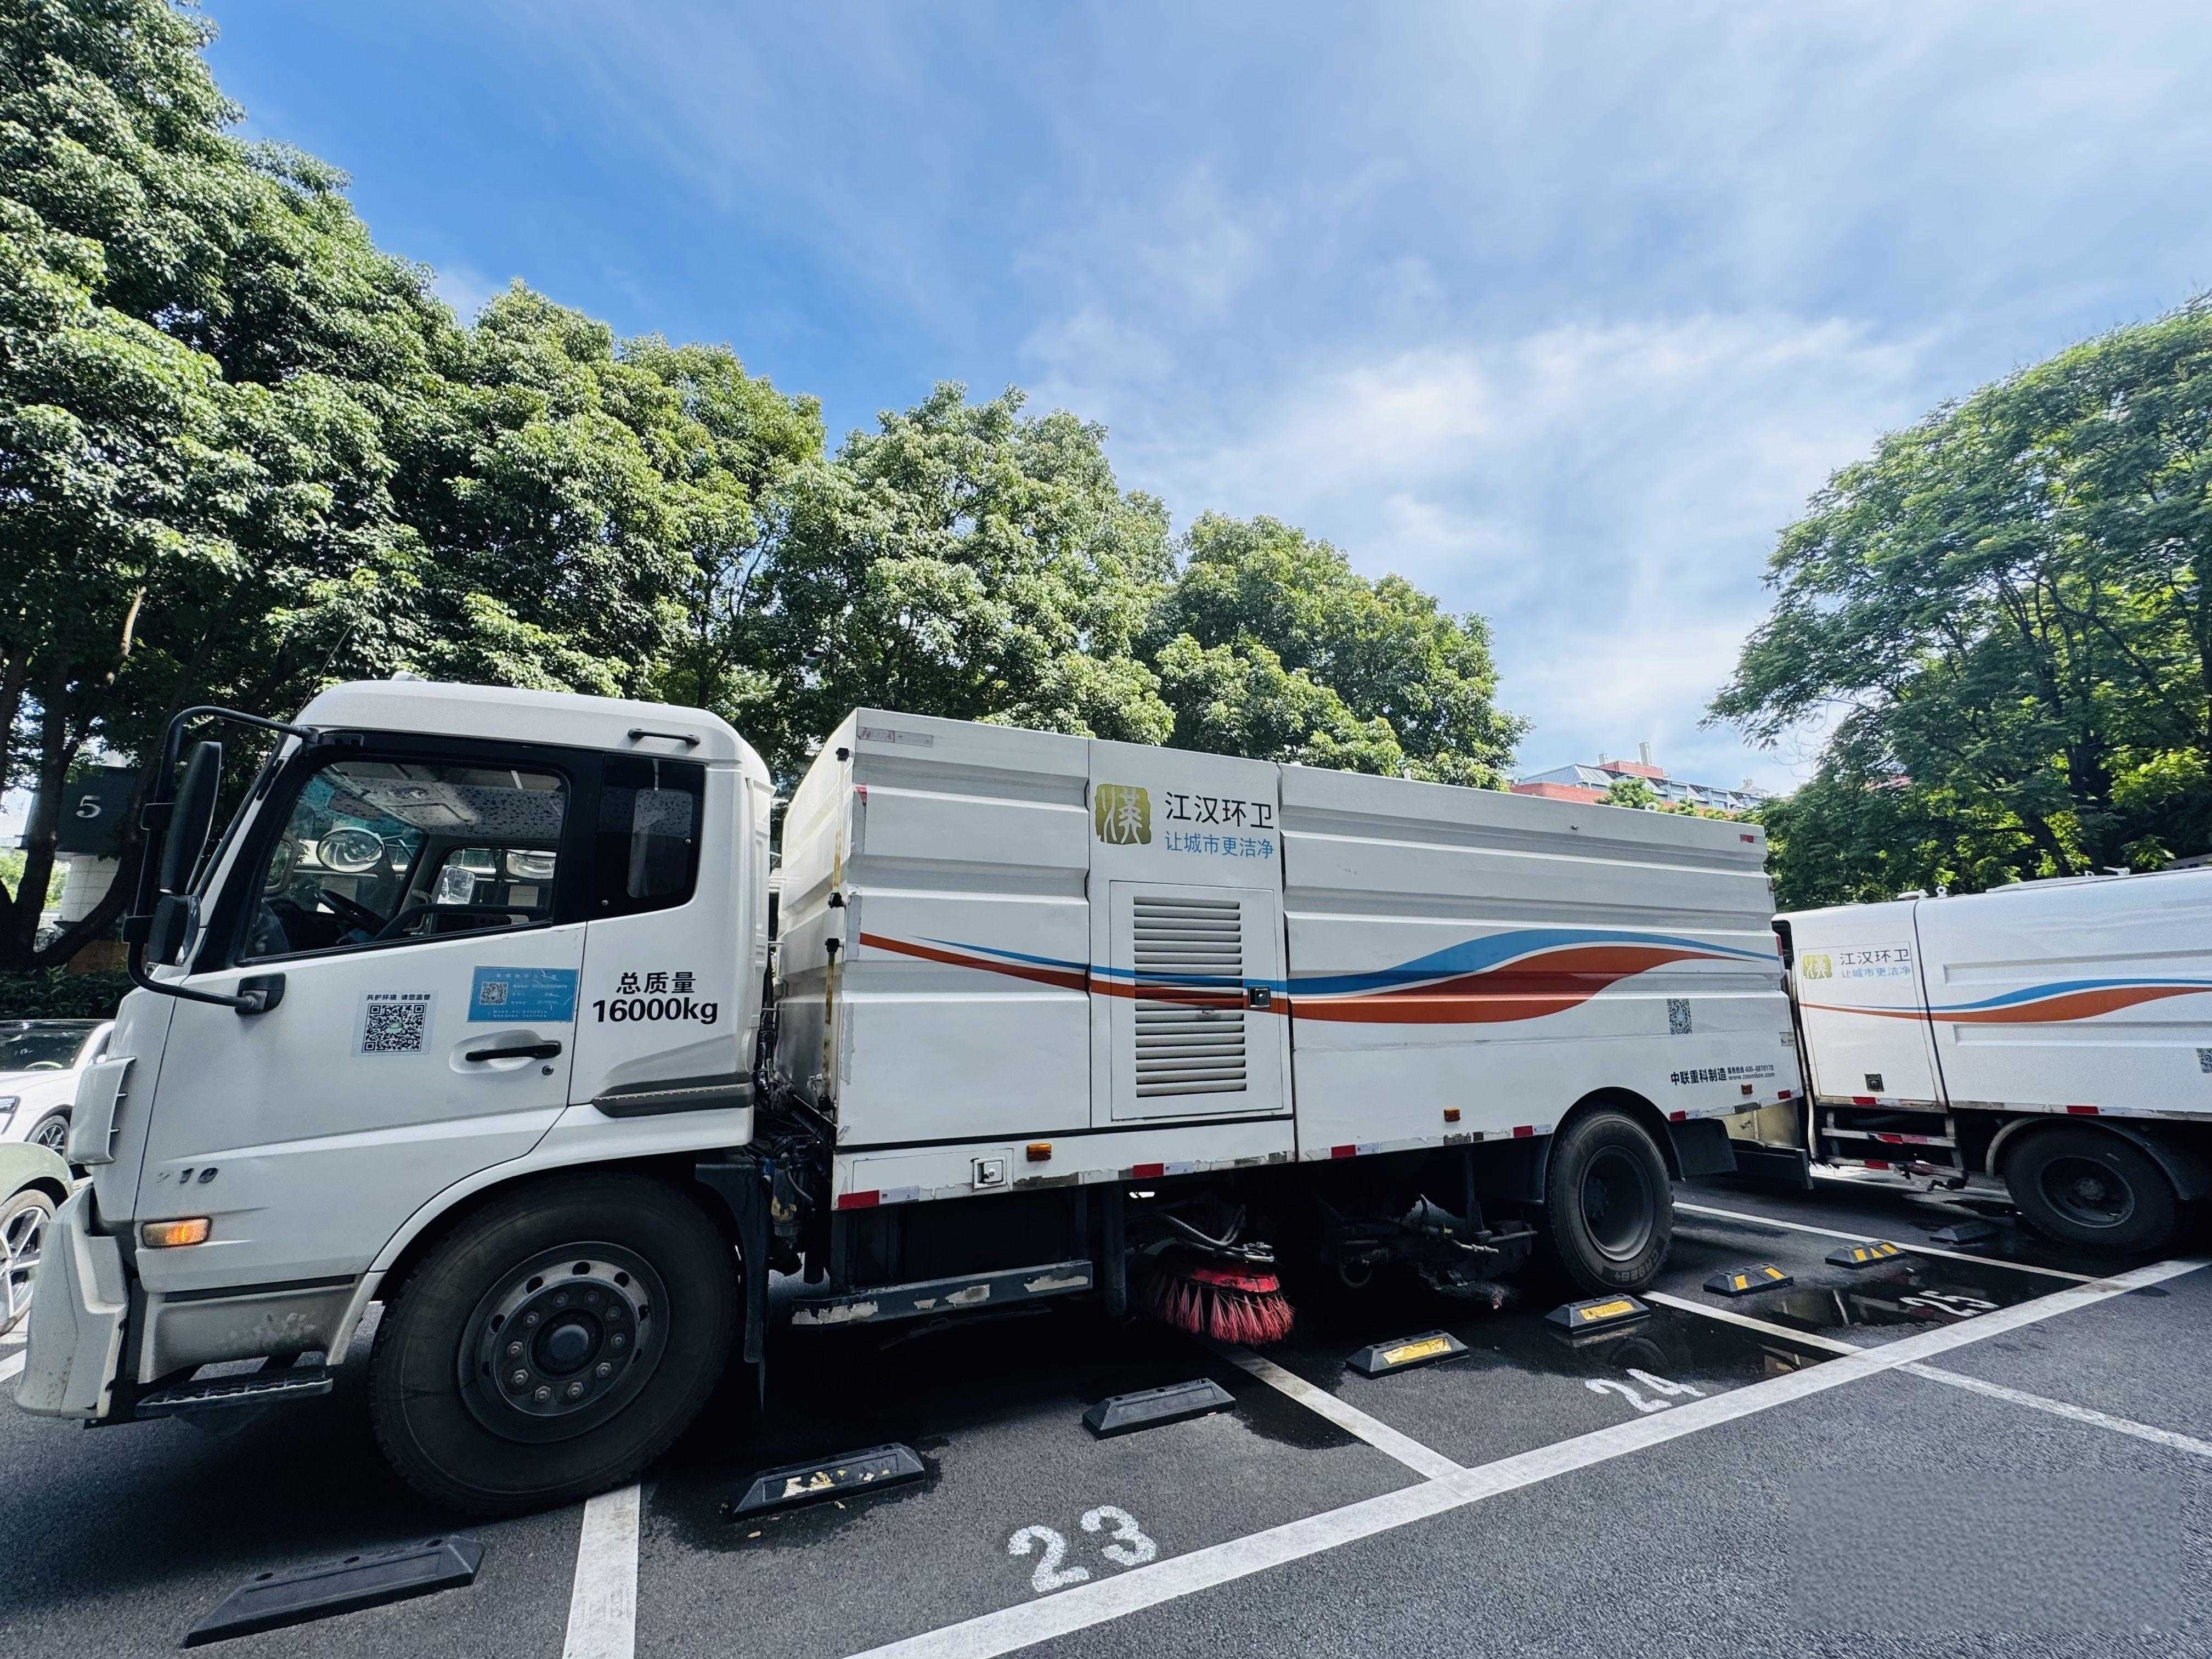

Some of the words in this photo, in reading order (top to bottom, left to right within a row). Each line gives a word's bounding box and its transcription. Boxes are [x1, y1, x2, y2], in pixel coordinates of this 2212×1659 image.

[76, 795, 101, 818] 5
[1165, 792, 1274, 830] 江汉环卫
[1165, 831, 1274, 859] 让城市更洁净
[1839, 949, 1911, 966] 江汉环卫
[616, 972, 696, 994] 总质量
[1841, 966, 1911, 978] 让城市更洁净
[592, 997, 718, 1025] 16000kg
[1671, 1067, 1727, 1086] 中联重科制造
[1899, 1290, 2001, 1317] 25
[1585, 1368, 1706, 1412] 24
[1008, 1505, 1156, 1592] 23
